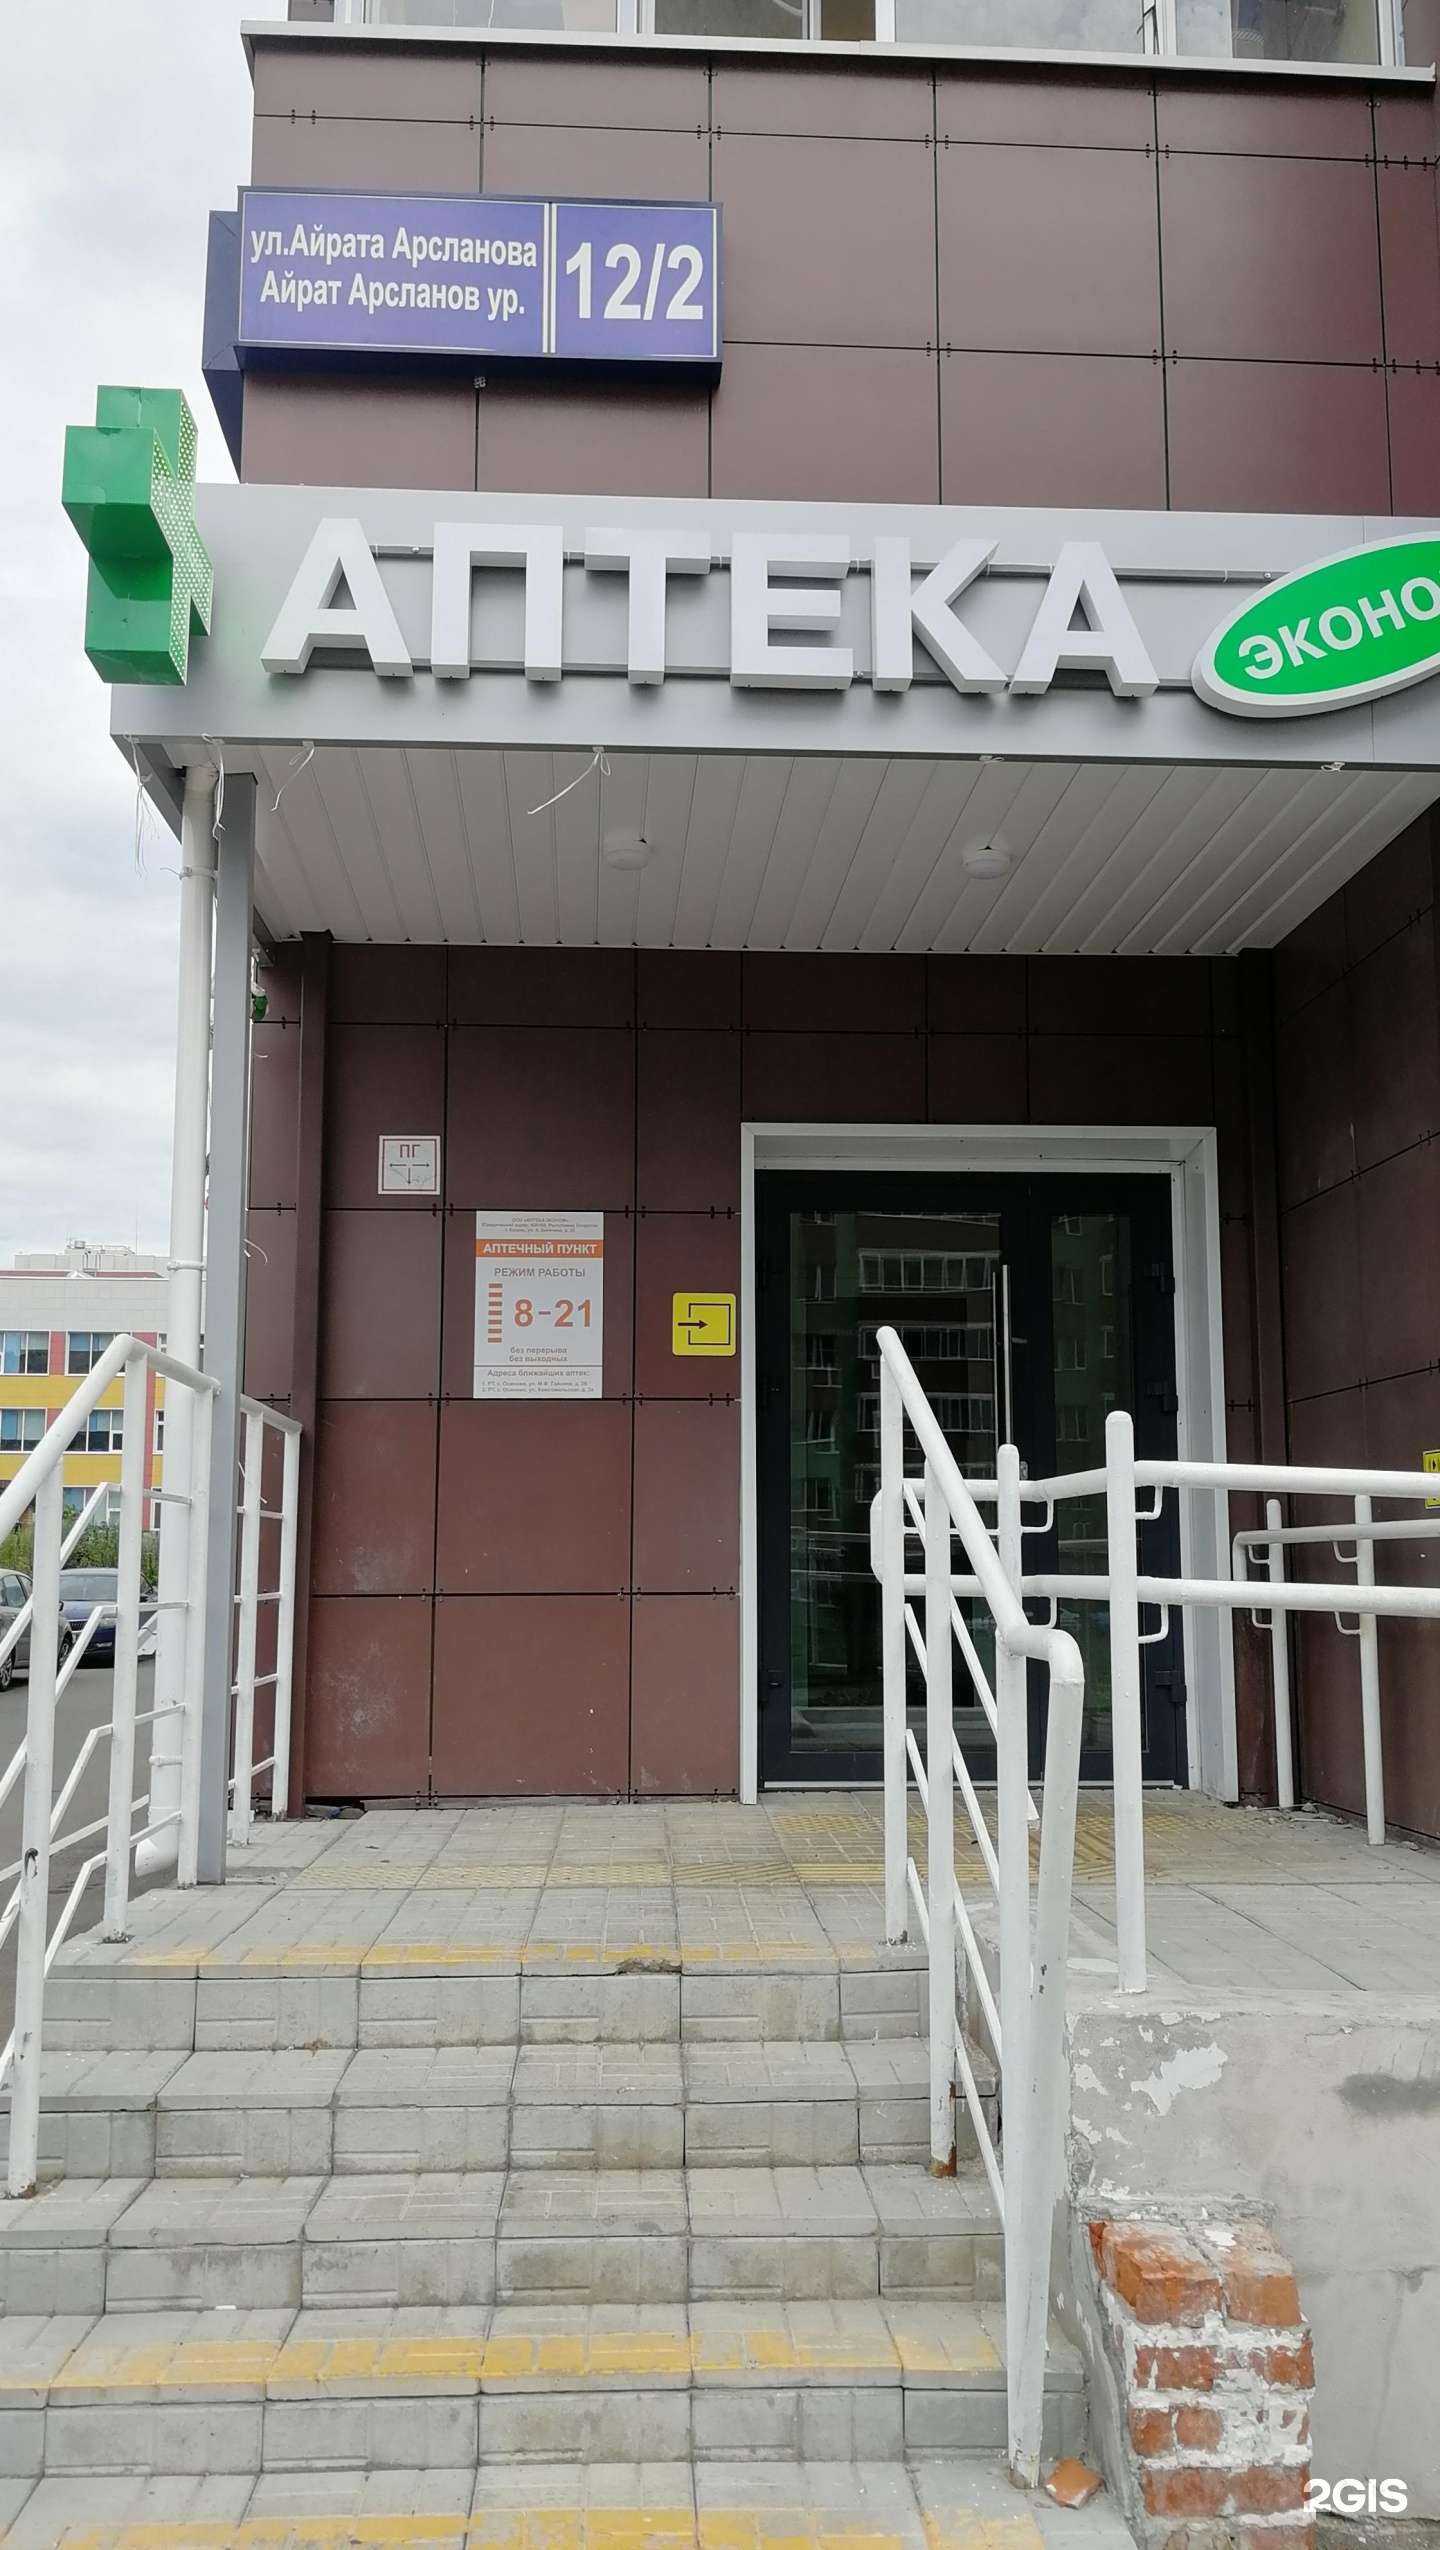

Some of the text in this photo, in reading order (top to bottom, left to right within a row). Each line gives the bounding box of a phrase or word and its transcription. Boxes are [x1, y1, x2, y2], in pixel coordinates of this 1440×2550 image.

[250, 223, 538, 268] ул.Айрата Арсланова
[259, 270, 527, 321] Айрат Арсланов ур.
[565, 241, 705, 321] 12/2
[259, 517, 1160, 697] АПТЕКА
[1238, 568, 1440, 680] ЭКОНО
[400, 1144, 421, 1158] ПГ
[483, 1241, 598, 1255] АПТЕЧНЫЙ ПУНКТ
[494, 1267, 586, 1278] РЕЖИМ РАБОТЫ
